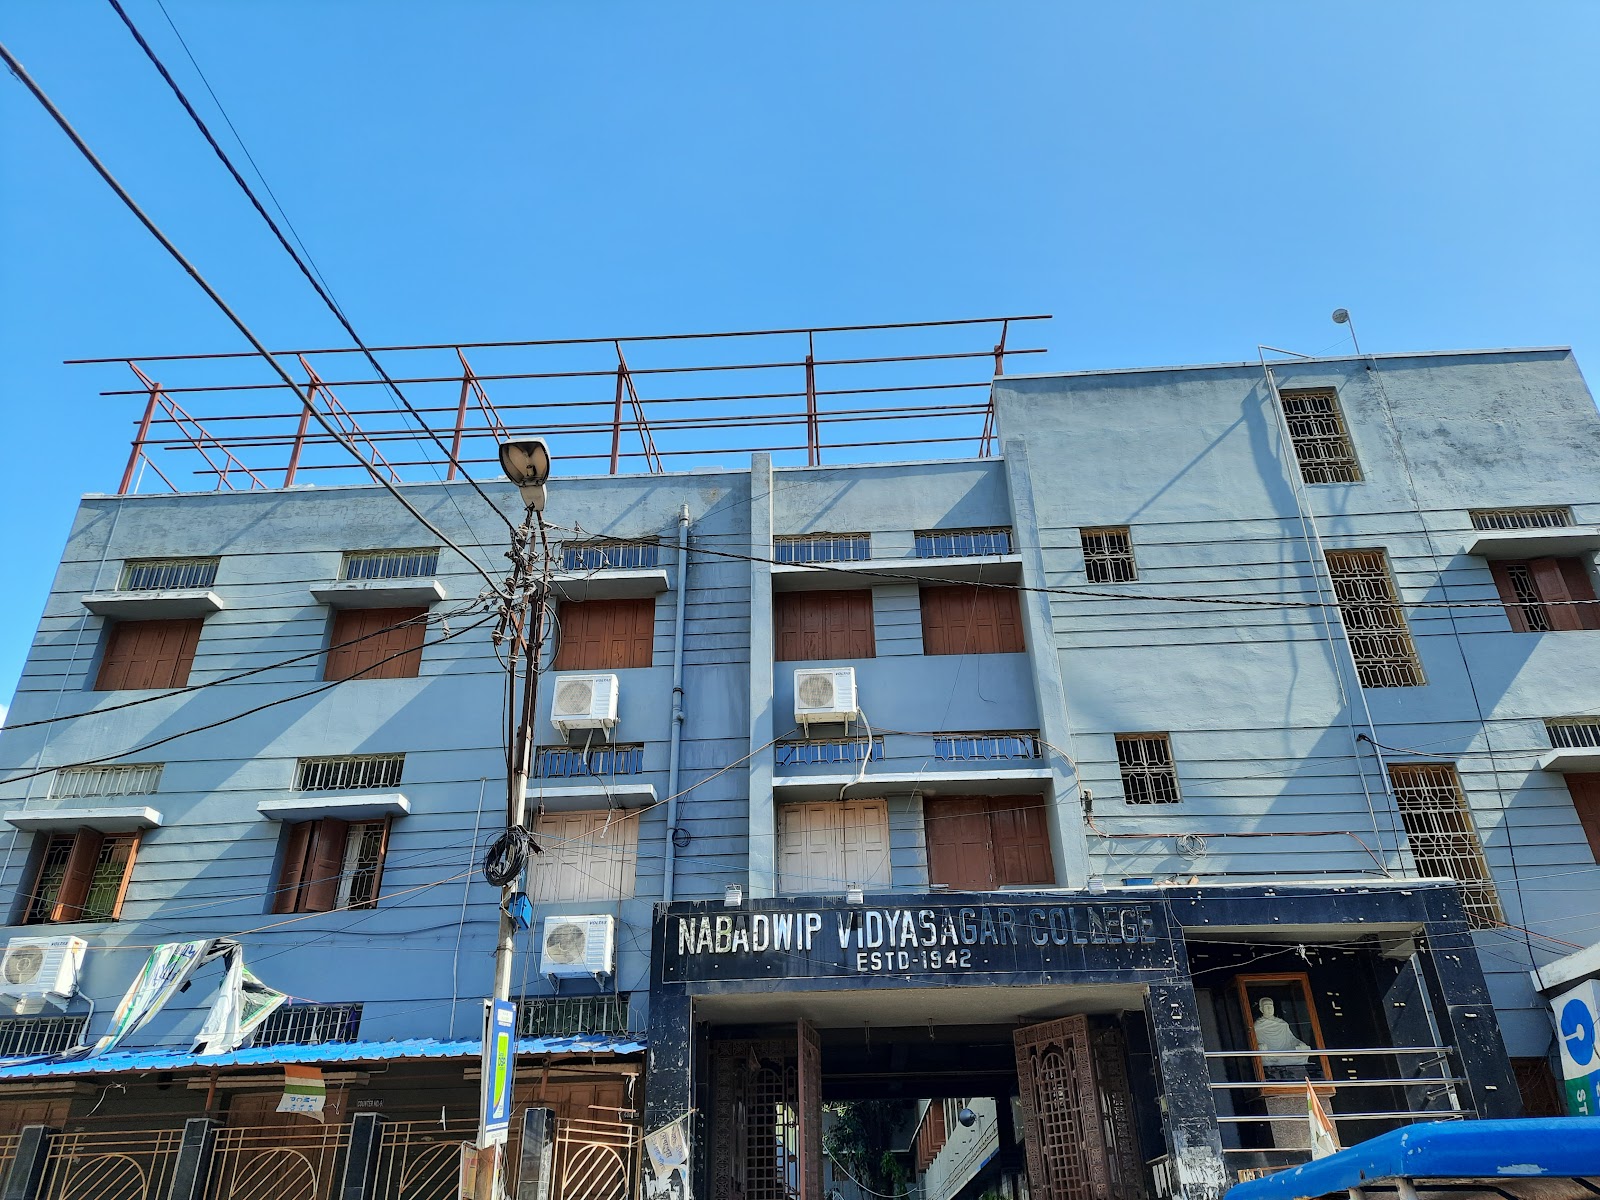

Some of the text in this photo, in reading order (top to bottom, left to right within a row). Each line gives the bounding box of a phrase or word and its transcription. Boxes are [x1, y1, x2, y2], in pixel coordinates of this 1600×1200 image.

[678, 905, 1156, 956] NABADWIP VIDYASAGAR COLLEGE
[856, 949, 972, 972] ESTD-1942
